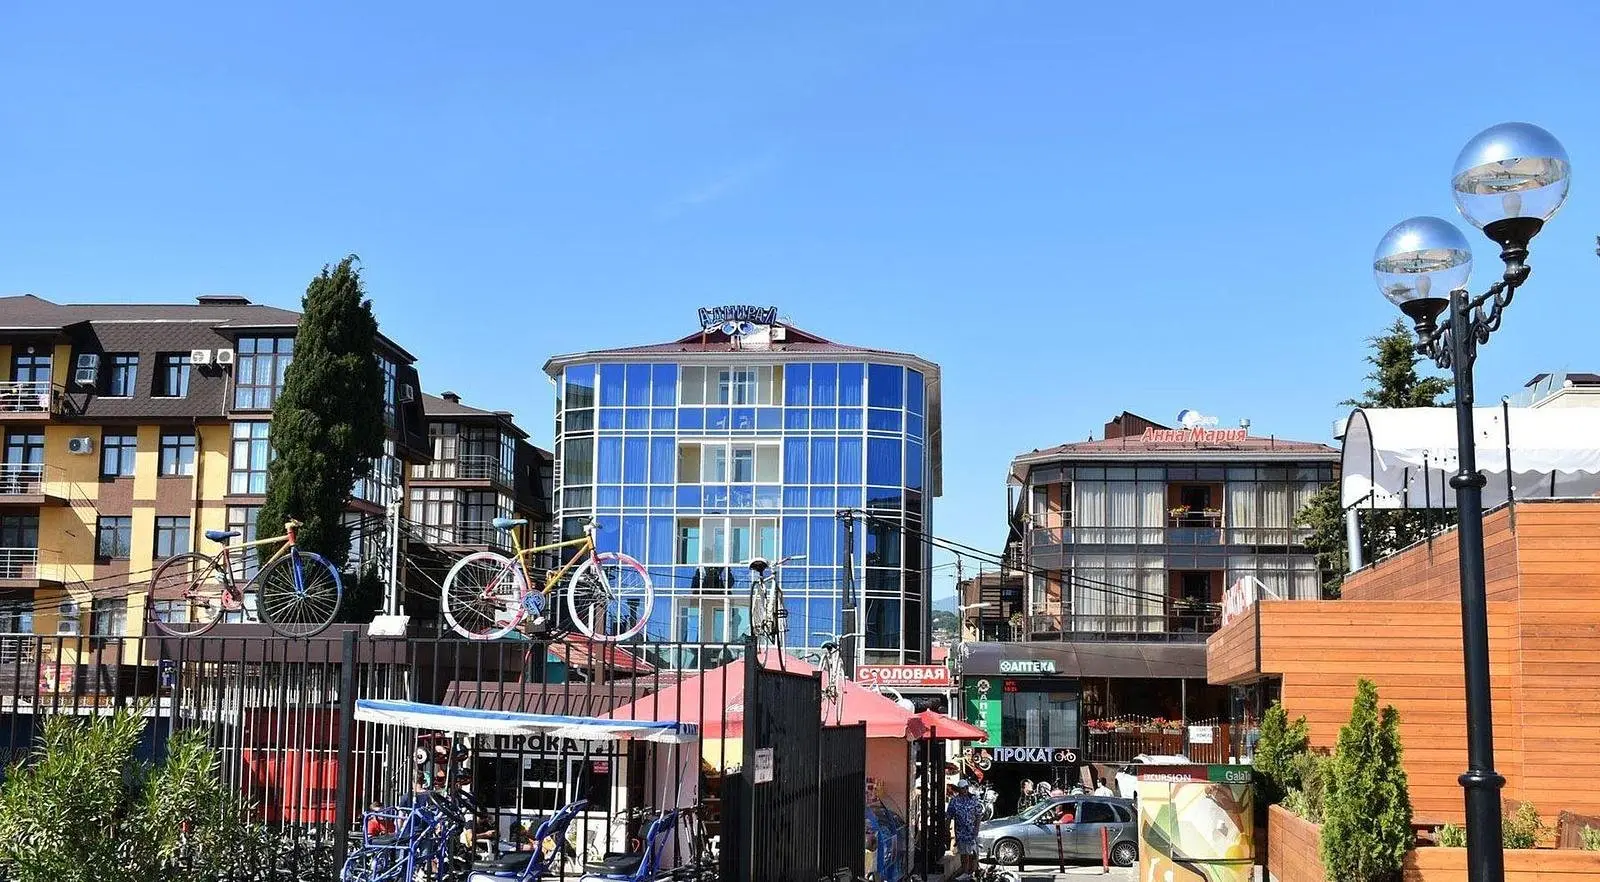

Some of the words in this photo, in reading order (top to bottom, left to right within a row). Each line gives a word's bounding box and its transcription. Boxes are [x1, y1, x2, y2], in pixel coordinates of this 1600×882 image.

[698, 305, 778, 327] АДМИРАЛ
[1140, 426, 1186, 443] Анна
[1189, 427, 1247, 445] Мария
[1010, 661, 1056, 673] АПТЕКА
[993, 747, 1054, 762] ПРОКАТ
